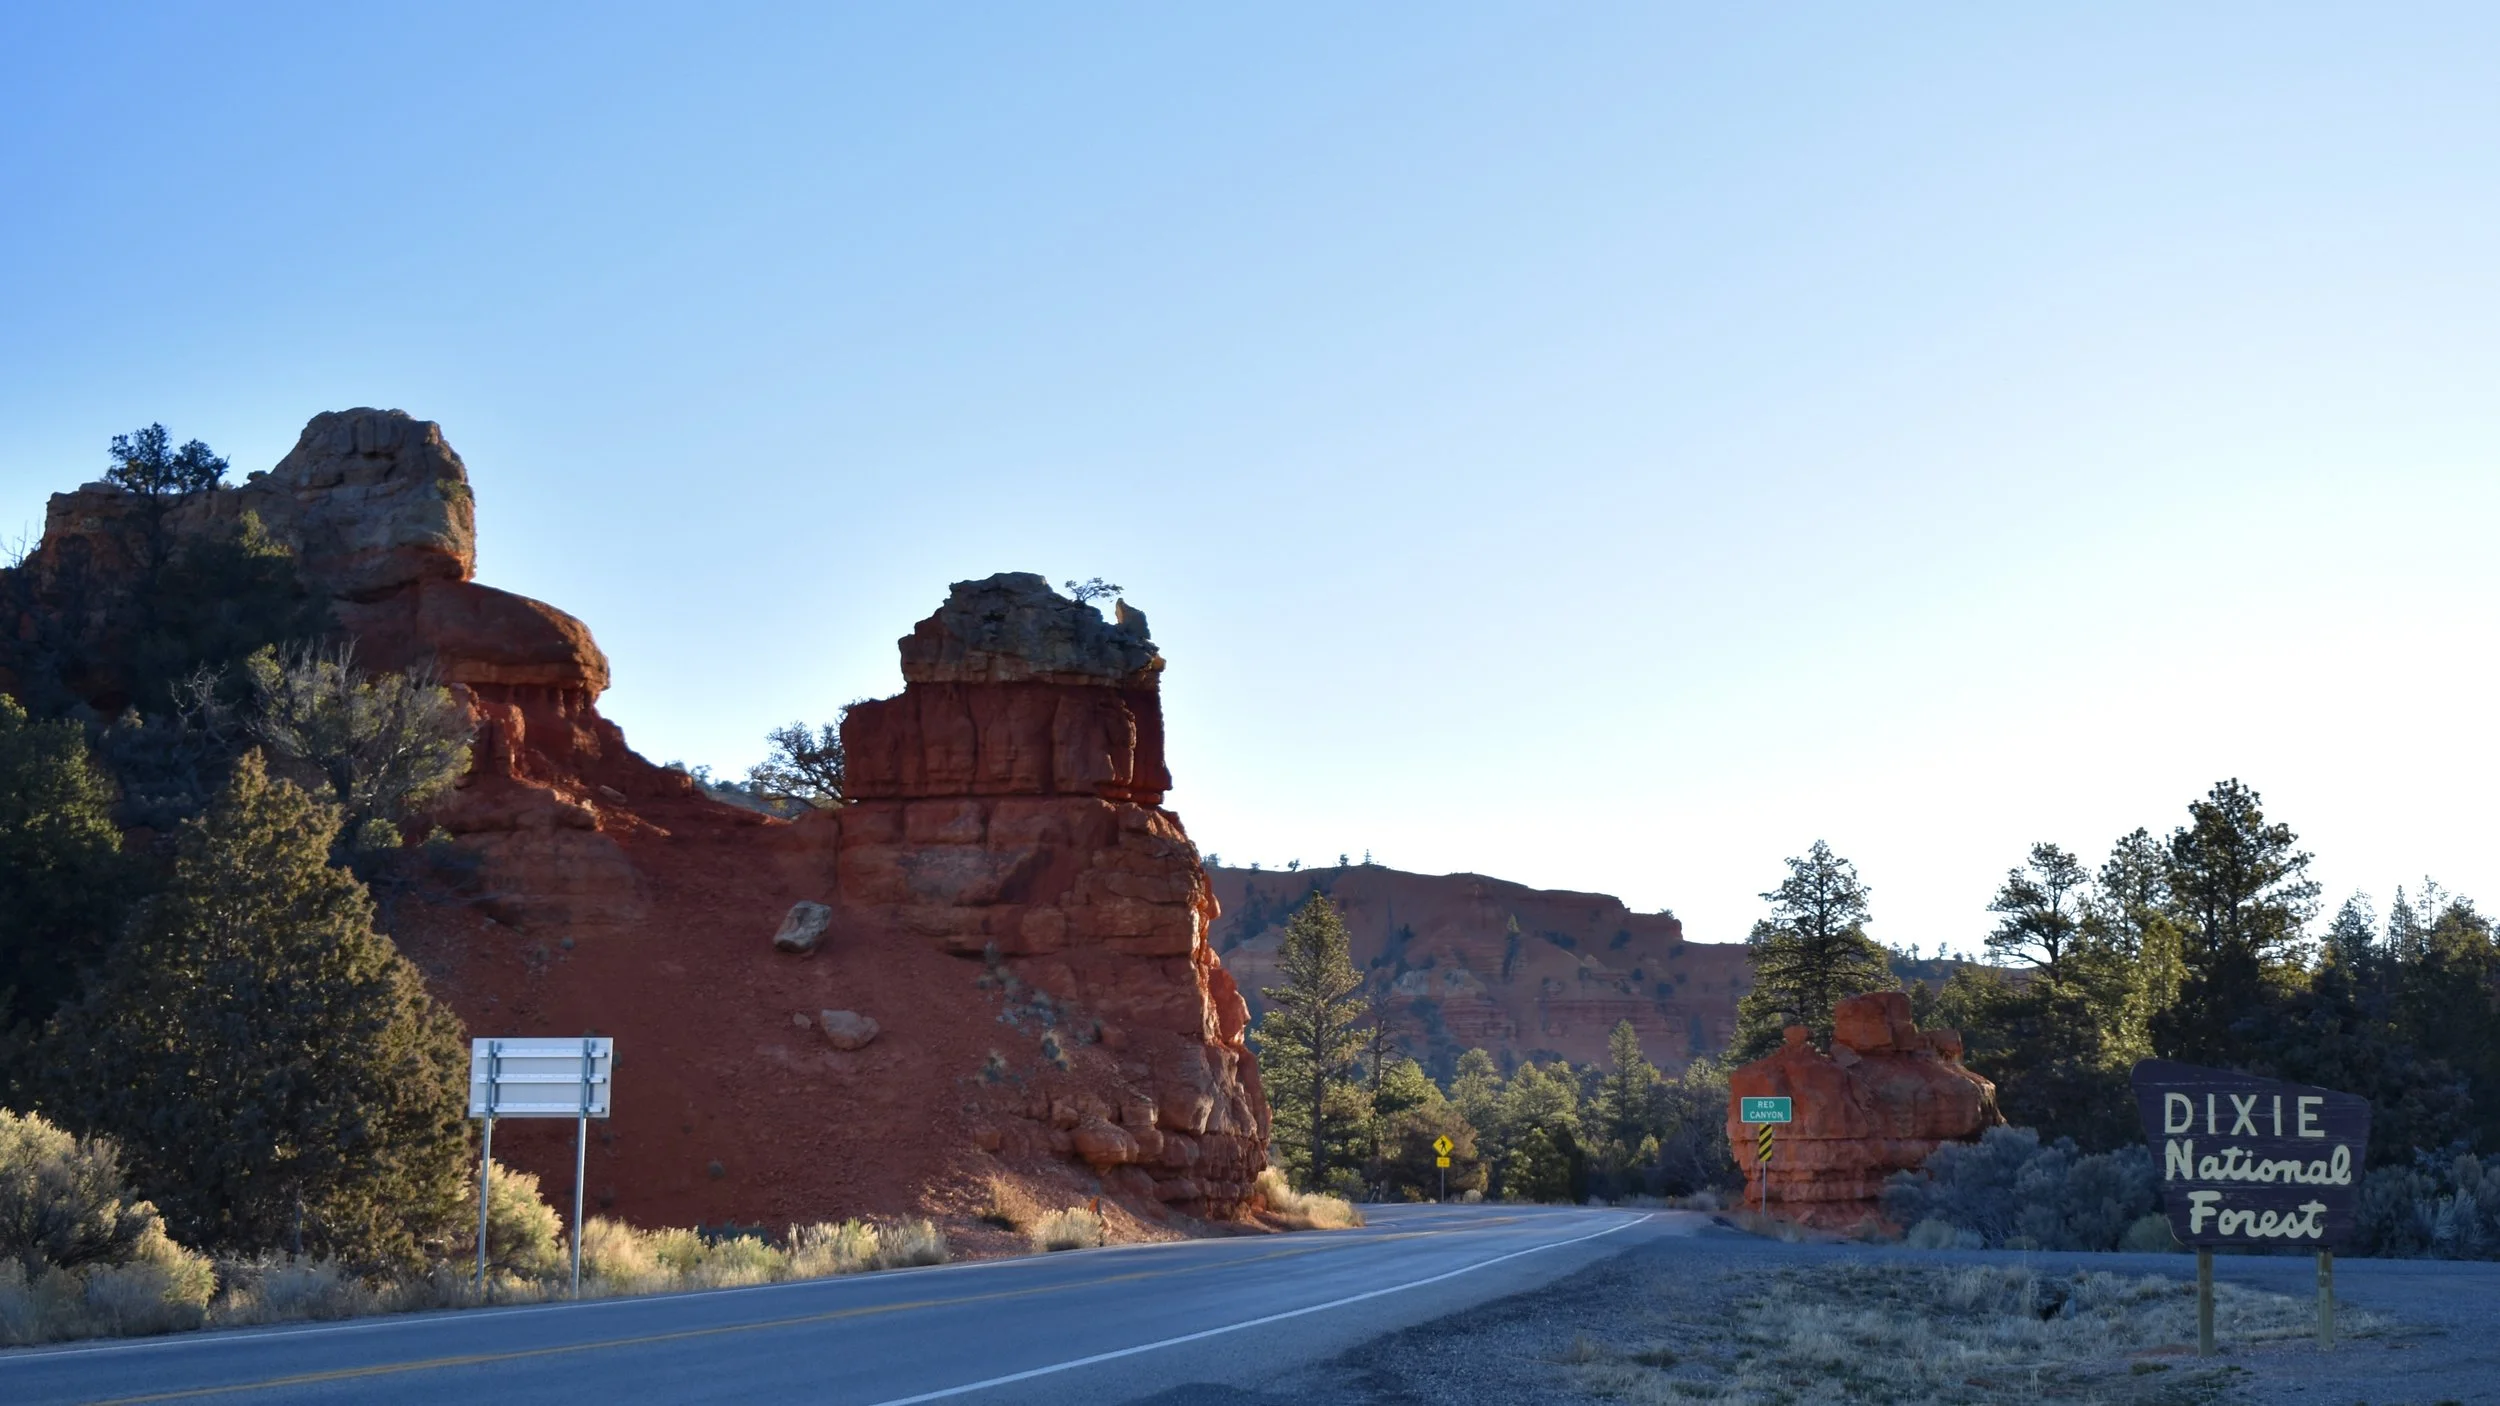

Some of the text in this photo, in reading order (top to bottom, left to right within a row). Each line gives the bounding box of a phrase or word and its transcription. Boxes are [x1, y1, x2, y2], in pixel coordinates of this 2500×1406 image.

[1749, 1111, 1784, 1119] CANYON
[1757, 1101, 1775, 1109] RED
[2164, 1092, 2326, 1138] DIXIE
[2165, 1138, 2352, 1186] National
[2187, 1190, 2328, 1239] Forest
